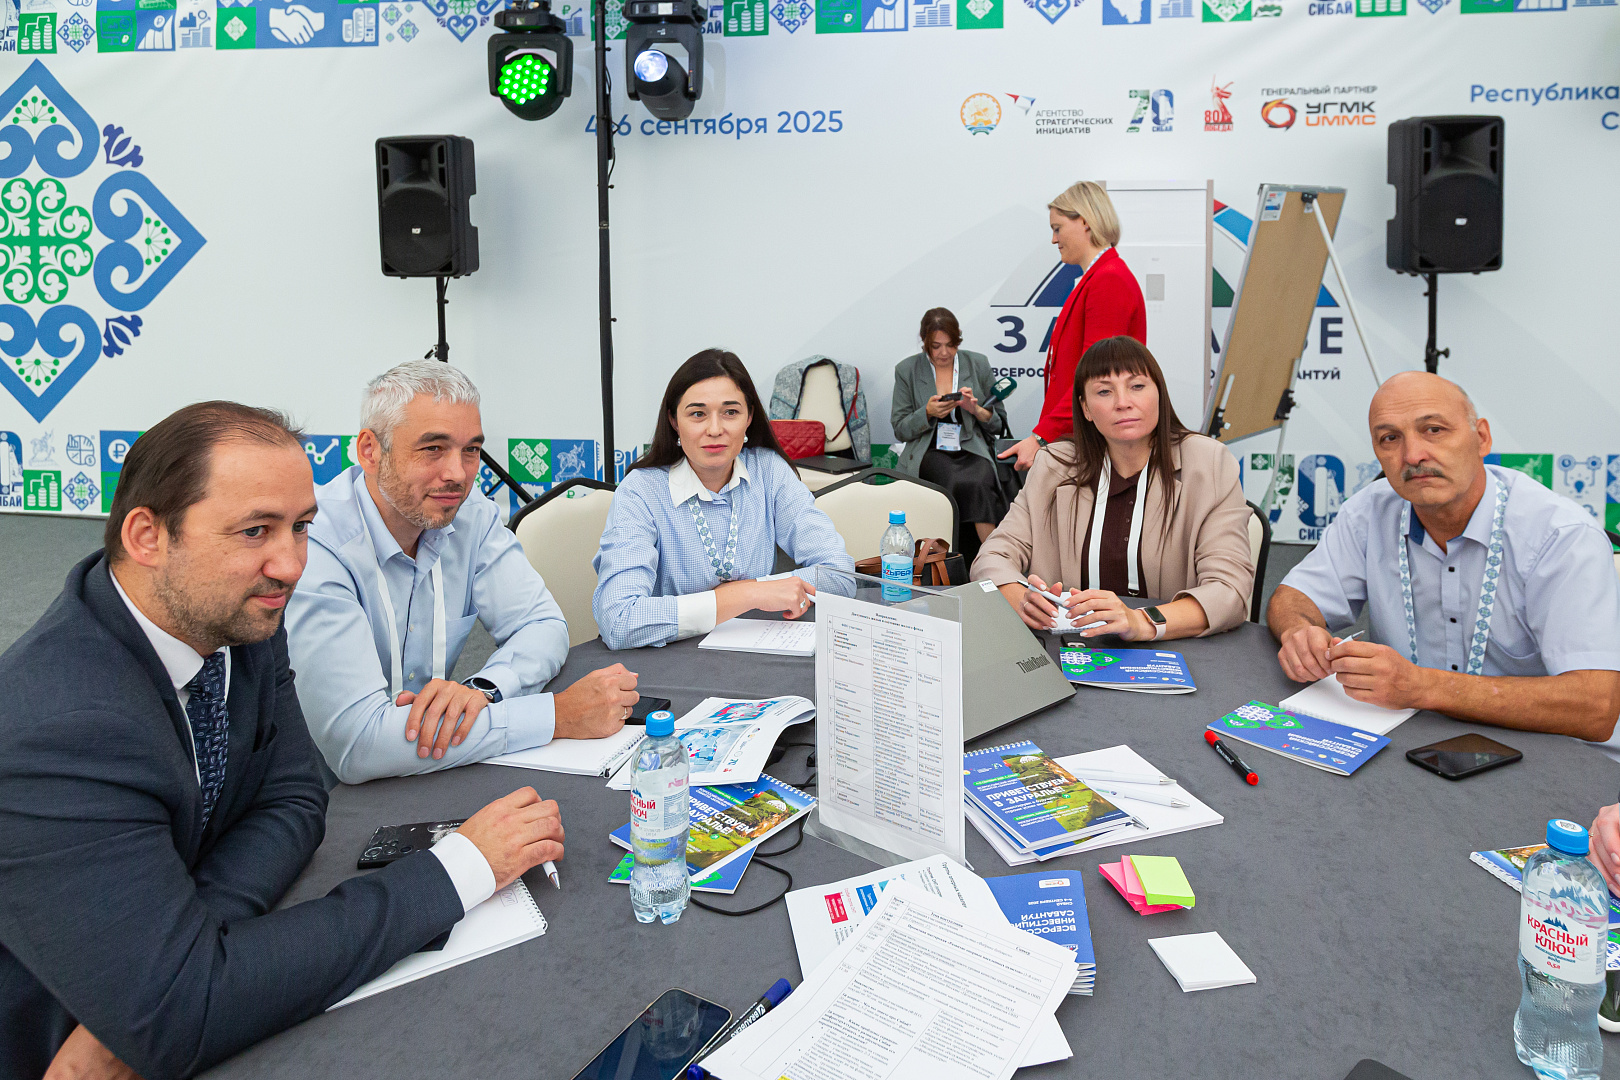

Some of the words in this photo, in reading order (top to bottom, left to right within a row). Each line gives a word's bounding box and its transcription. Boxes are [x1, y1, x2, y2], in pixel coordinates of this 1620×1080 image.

[1308, 2, 1353, 16] СИБАЙ
[701, 21, 723, 34] БАЙ
[1261, 85, 1331, 96] ГЕНЕРАЛЬНЫЙ
[1333, 86, 1378, 94] ПАРТНЕР
[1471, 83, 1620, 106] Республика
[1035, 109, 1084, 118] АГЕНТСТВО
[1306, 101, 1376, 114] УГМК
[640, 112, 768, 140] сентября
[777, 110, 843, 134] 2025
[1035, 117, 1113, 126] СТРАТЕГИЧЕСКИХ
[1306, 115, 1376, 127] UMMC
[1036, 127, 1091, 135] ИНИЦИАТИВ
[1016, 654, 1051, 674] ThinkBook
[985, 776, 1070, 801] ПРИВЕТСТВУЕМ
[993, 800, 1004, 808] В
[1006, 785, 1066, 805] ЗАУРАЛЬЕ!
[689, 807, 734, 835] АУРАЛЬЕ!
[1021, 910, 1075, 921] САБАНТУЙ
[1010, 917, 1076, 928] ИНВЕСТИЦИ
[1026, 925, 1077, 934] ВСЕРОСС
[1527, 914, 1588, 947] КРАСНЫЙ
[1535, 933, 1576, 958] КЛЮЧ
